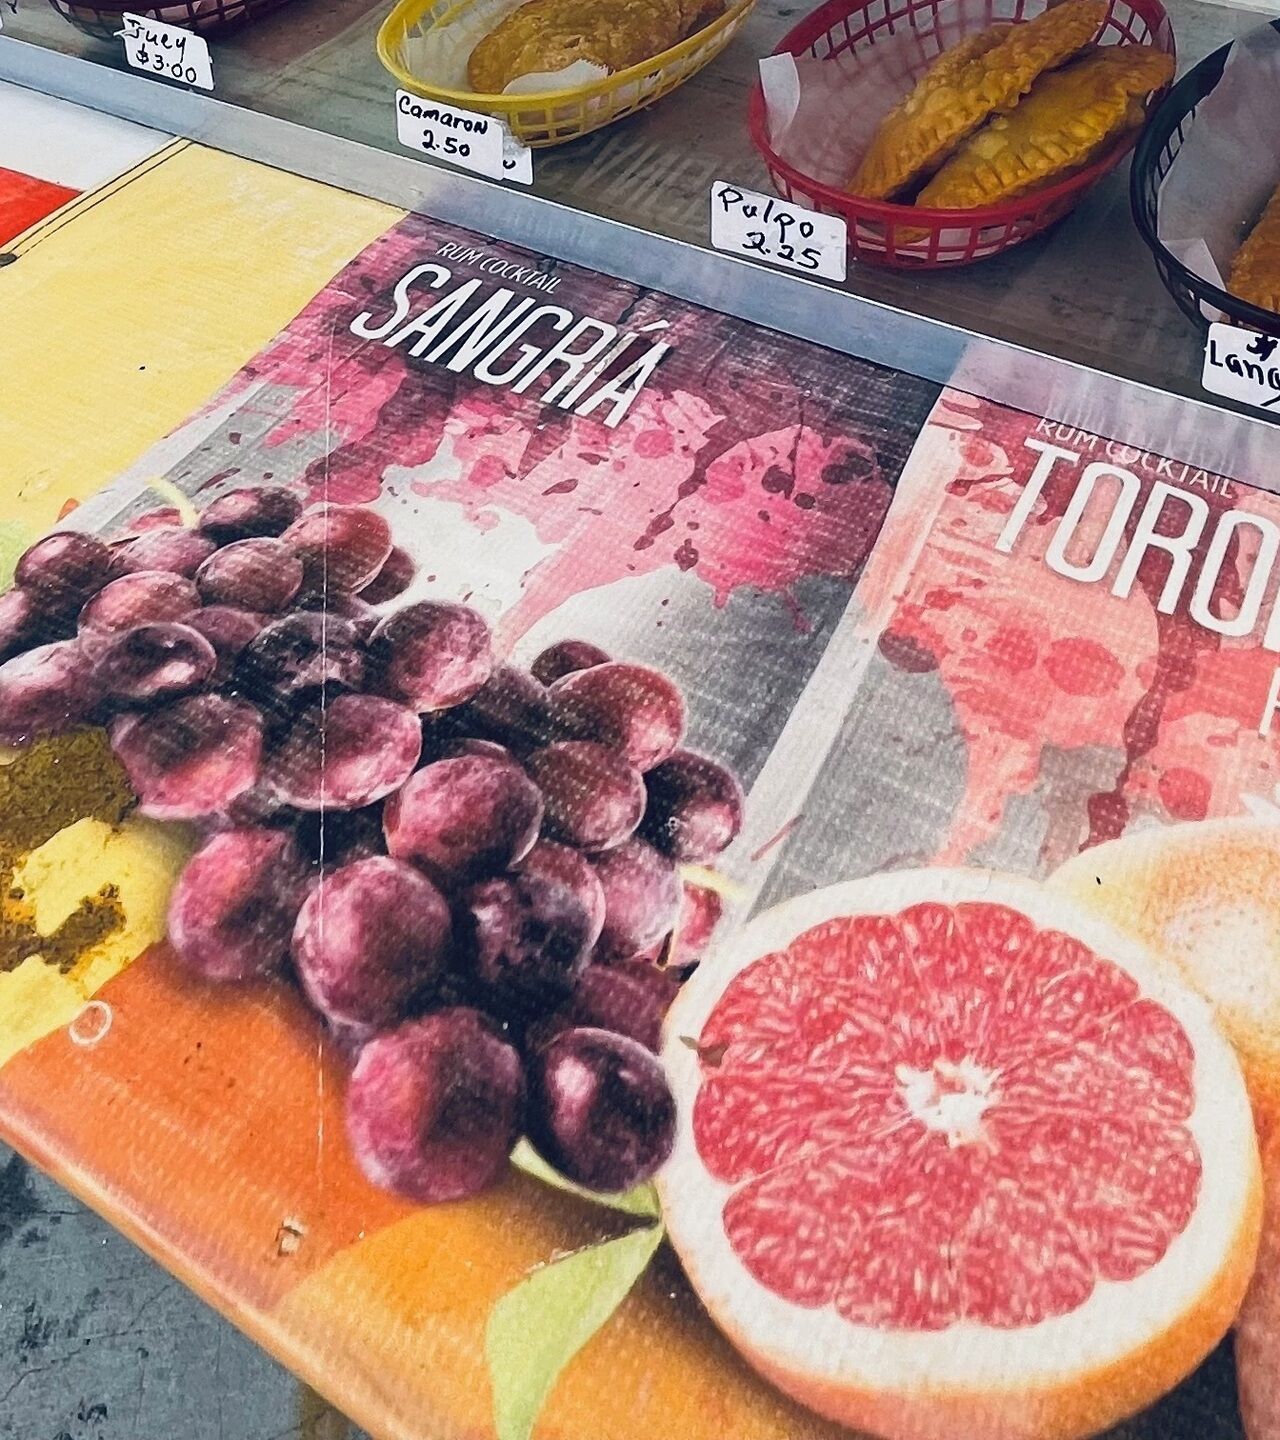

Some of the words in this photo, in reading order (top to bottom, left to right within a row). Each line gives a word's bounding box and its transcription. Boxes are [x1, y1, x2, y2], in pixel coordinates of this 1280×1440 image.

[122, 18, 186, 64] Juey
[136, 43, 197, 83] $3.00
[422, 129, 471, 157] 2.50
[717, 187, 814, 244] Pulpo
[435, 242, 483, 264] RUM
[480, 257, 563, 295] COCKTAIL
[742, 231, 822, 270] 2.25
[349, 262, 670, 429] SANGRÍA
[1036, 417, 1098, 453] RUM
[1105, 434, 1237, 500] COCKTAIL
